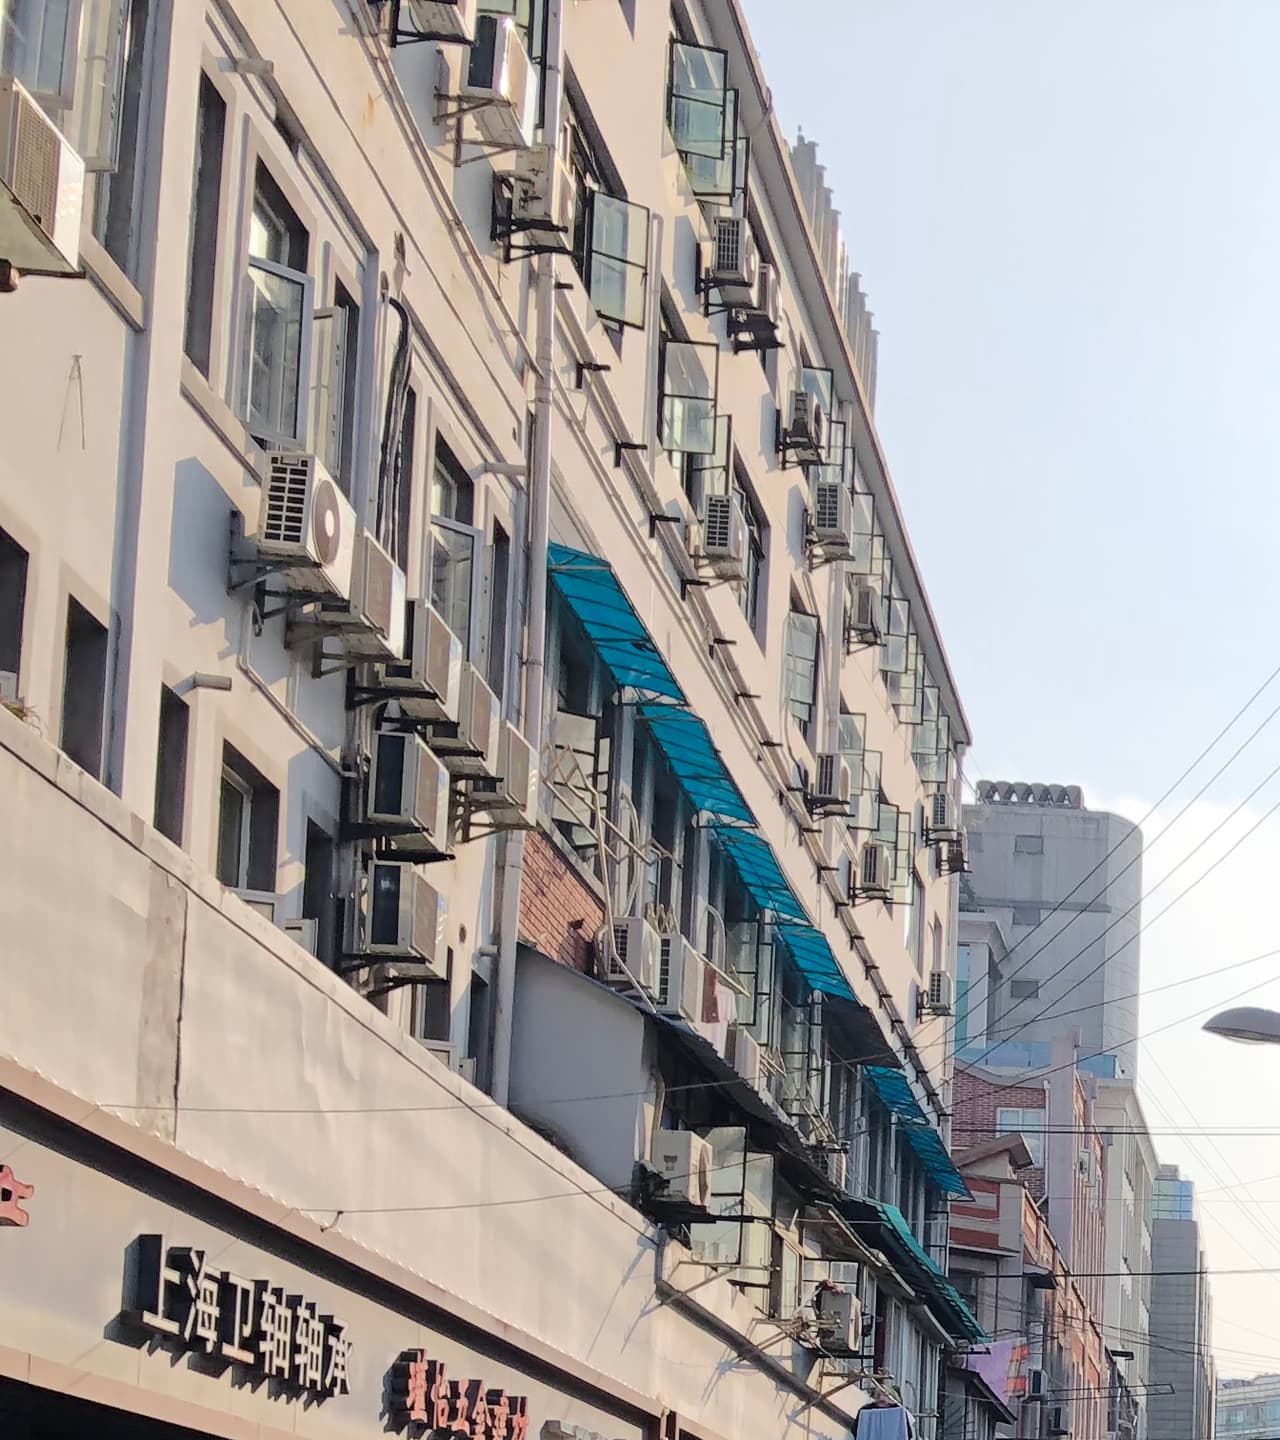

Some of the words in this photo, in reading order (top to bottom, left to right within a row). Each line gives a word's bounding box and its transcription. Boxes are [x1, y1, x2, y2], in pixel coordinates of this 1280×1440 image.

[141, 1234, 353, 1397] 上海卫轴轴承
